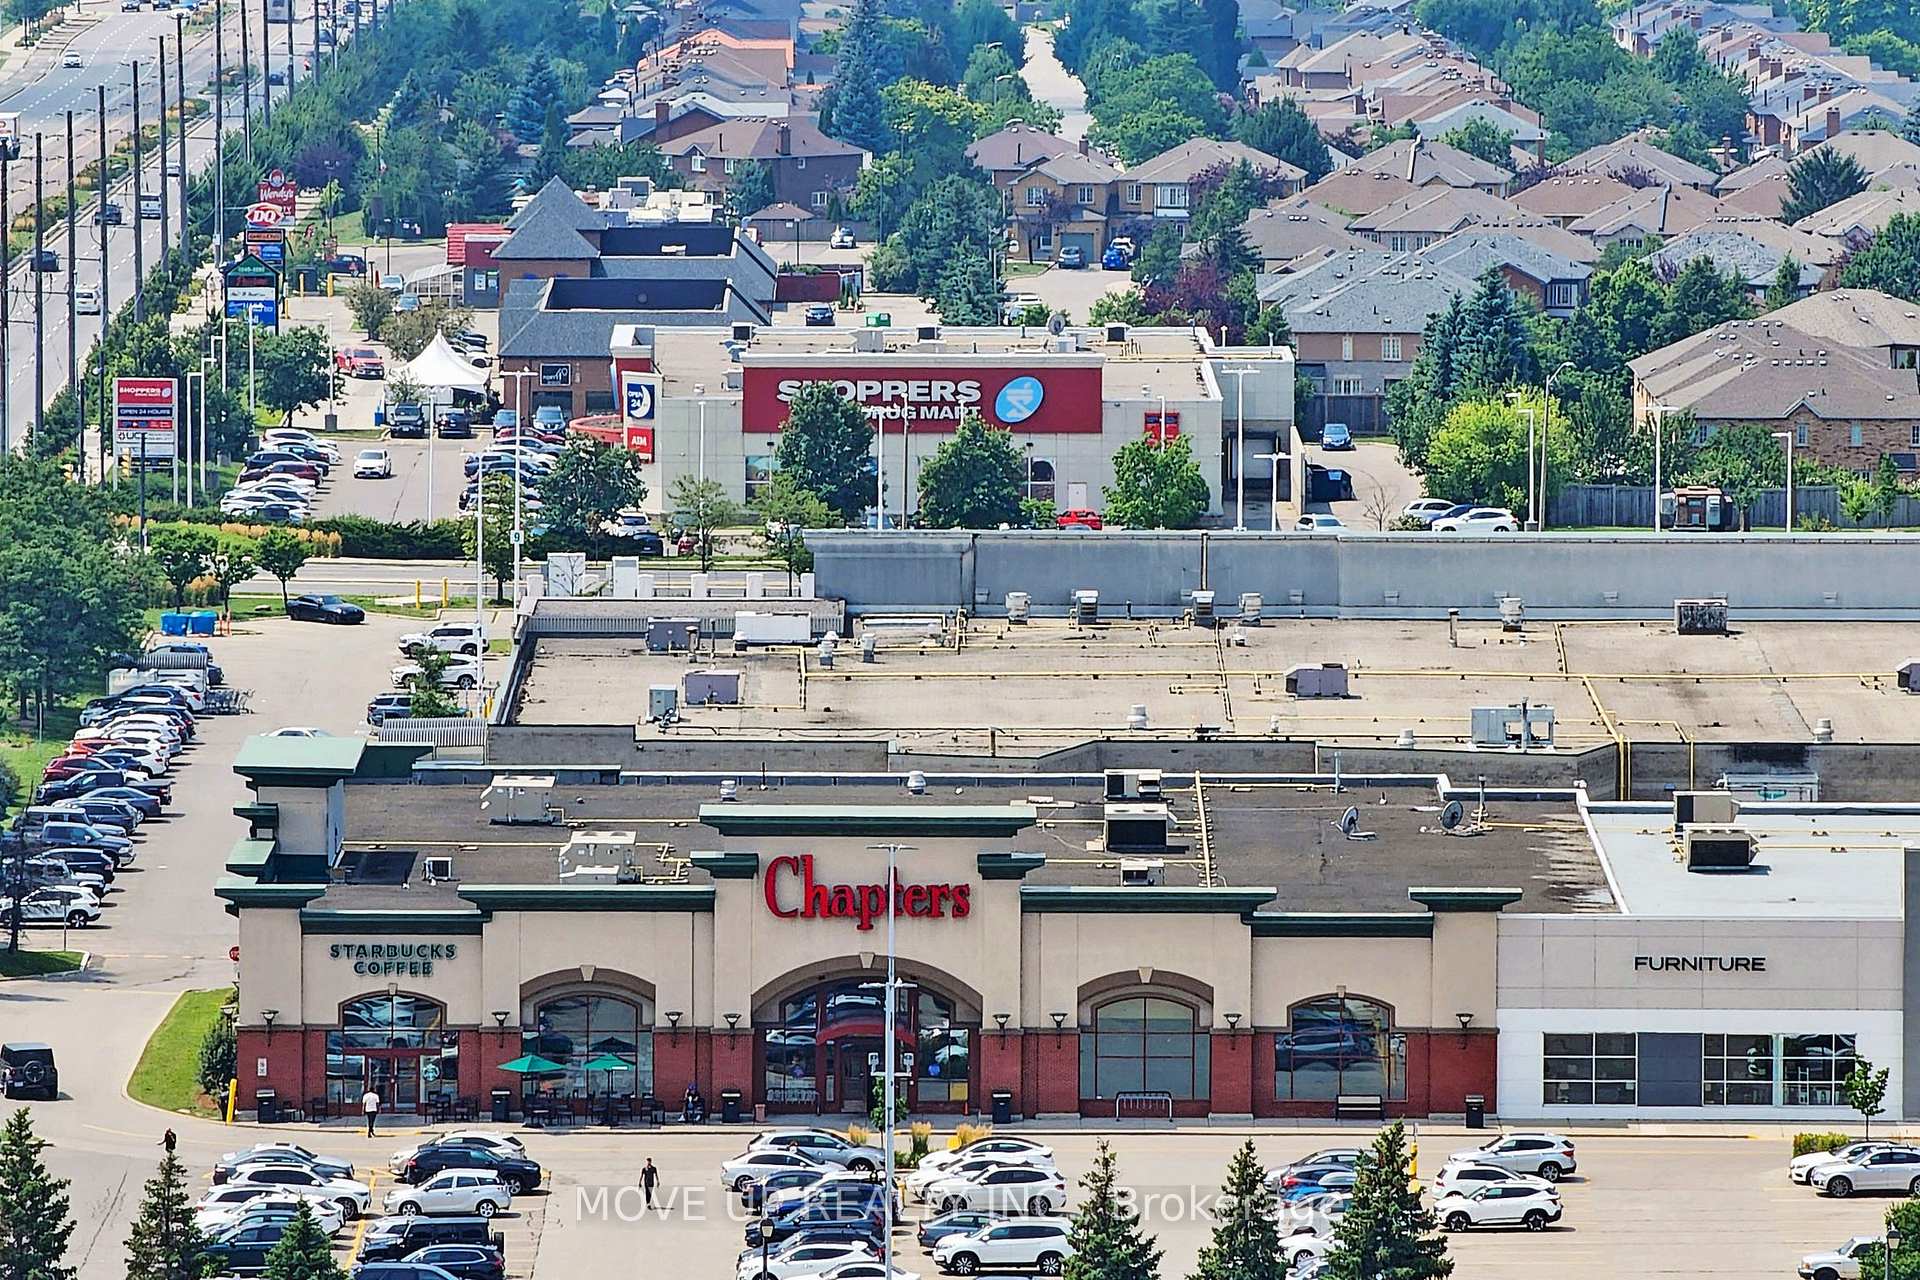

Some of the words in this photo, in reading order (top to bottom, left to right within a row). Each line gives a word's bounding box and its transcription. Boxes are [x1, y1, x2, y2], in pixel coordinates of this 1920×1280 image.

[260, 187, 294, 201] Wendy's
[253, 210, 276, 224] DQ
[776, 379, 982, 402] SOPPERS
[514, 532, 520, 542] 9
[330, 944, 456, 960] STARBUCKS
[354, 961, 433, 976] COFFEE
[1634, 956, 1766, 971] FURNITURE
